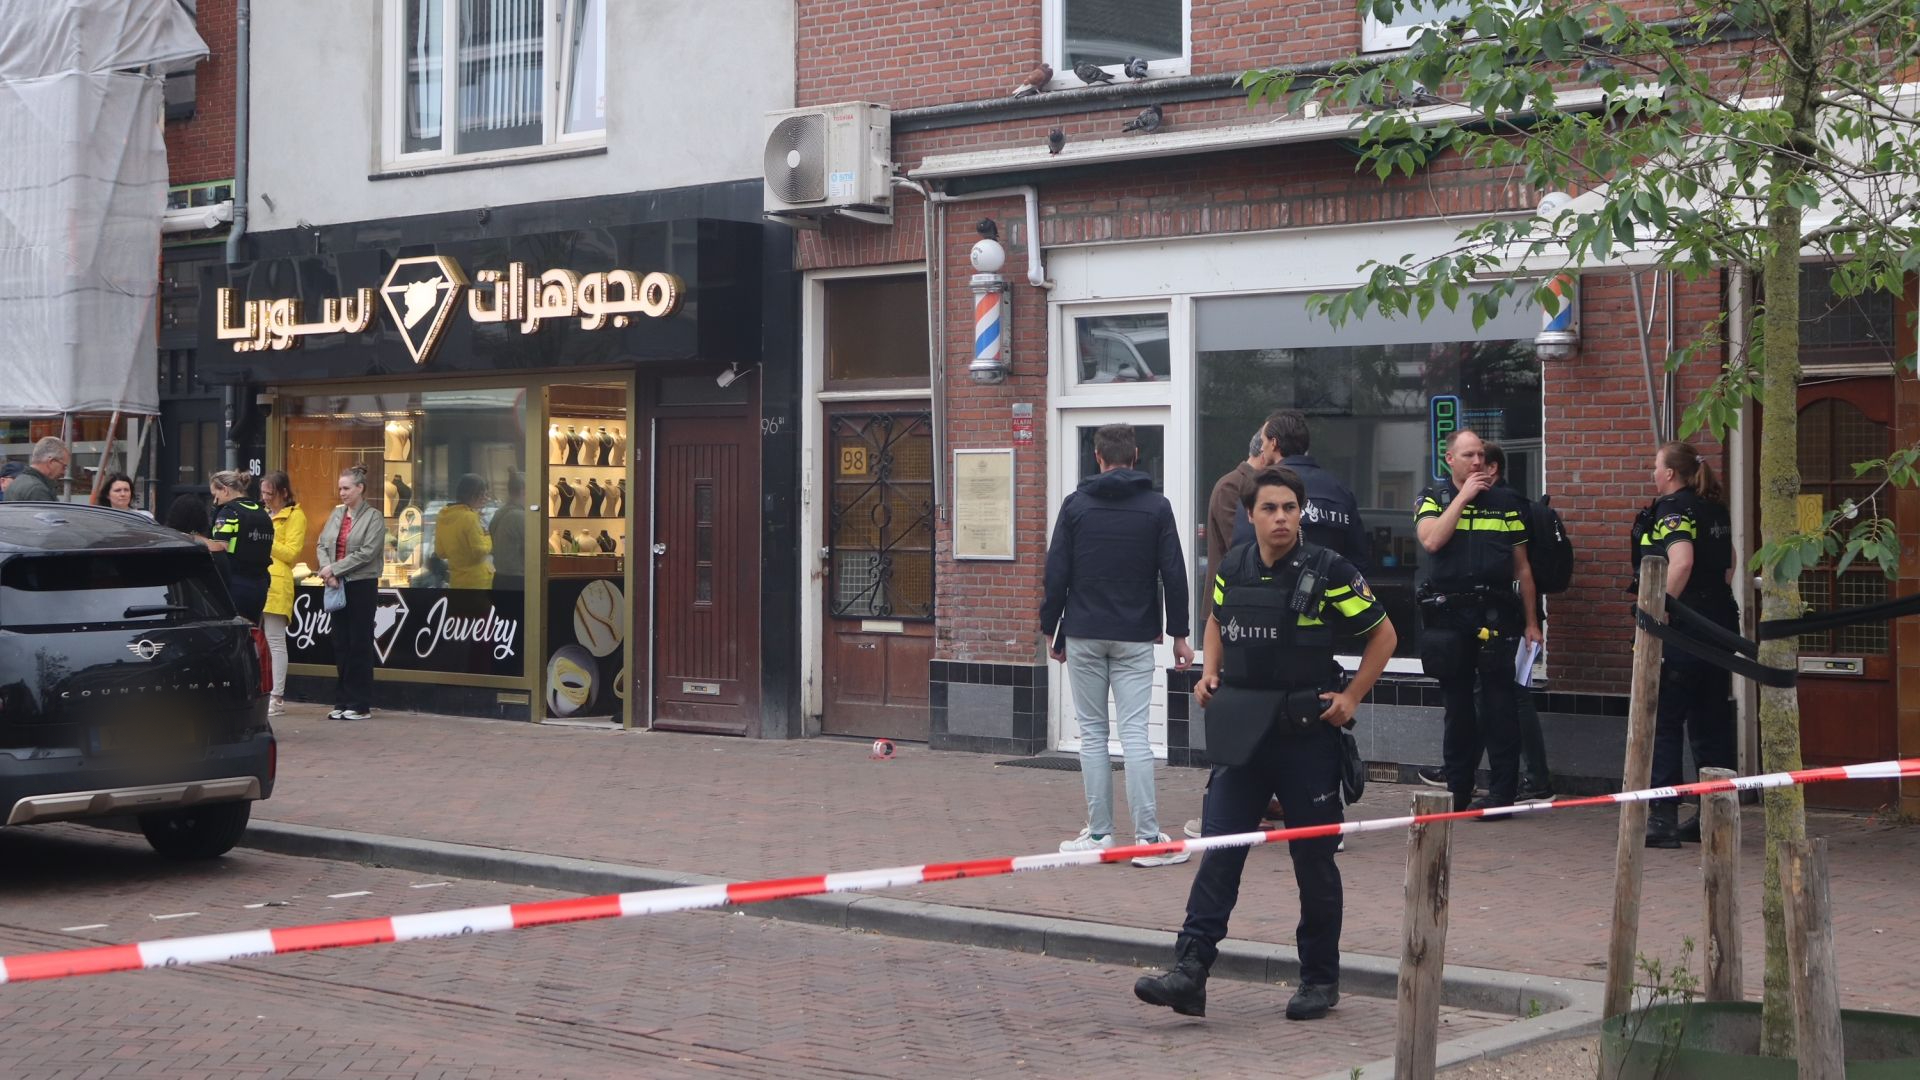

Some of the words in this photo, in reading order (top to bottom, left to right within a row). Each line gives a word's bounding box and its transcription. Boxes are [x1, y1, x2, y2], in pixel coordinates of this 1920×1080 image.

[469, 262, 677, 334] مجوهرات
[249, 459, 261, 476] 96
[843, 450, 864, 470] 98
[415, 597, 518, 660] Jewelry
[1221, 616, 1278, 641] POLITIE
[61, 681, 231, 698] COUNTRYMAN
